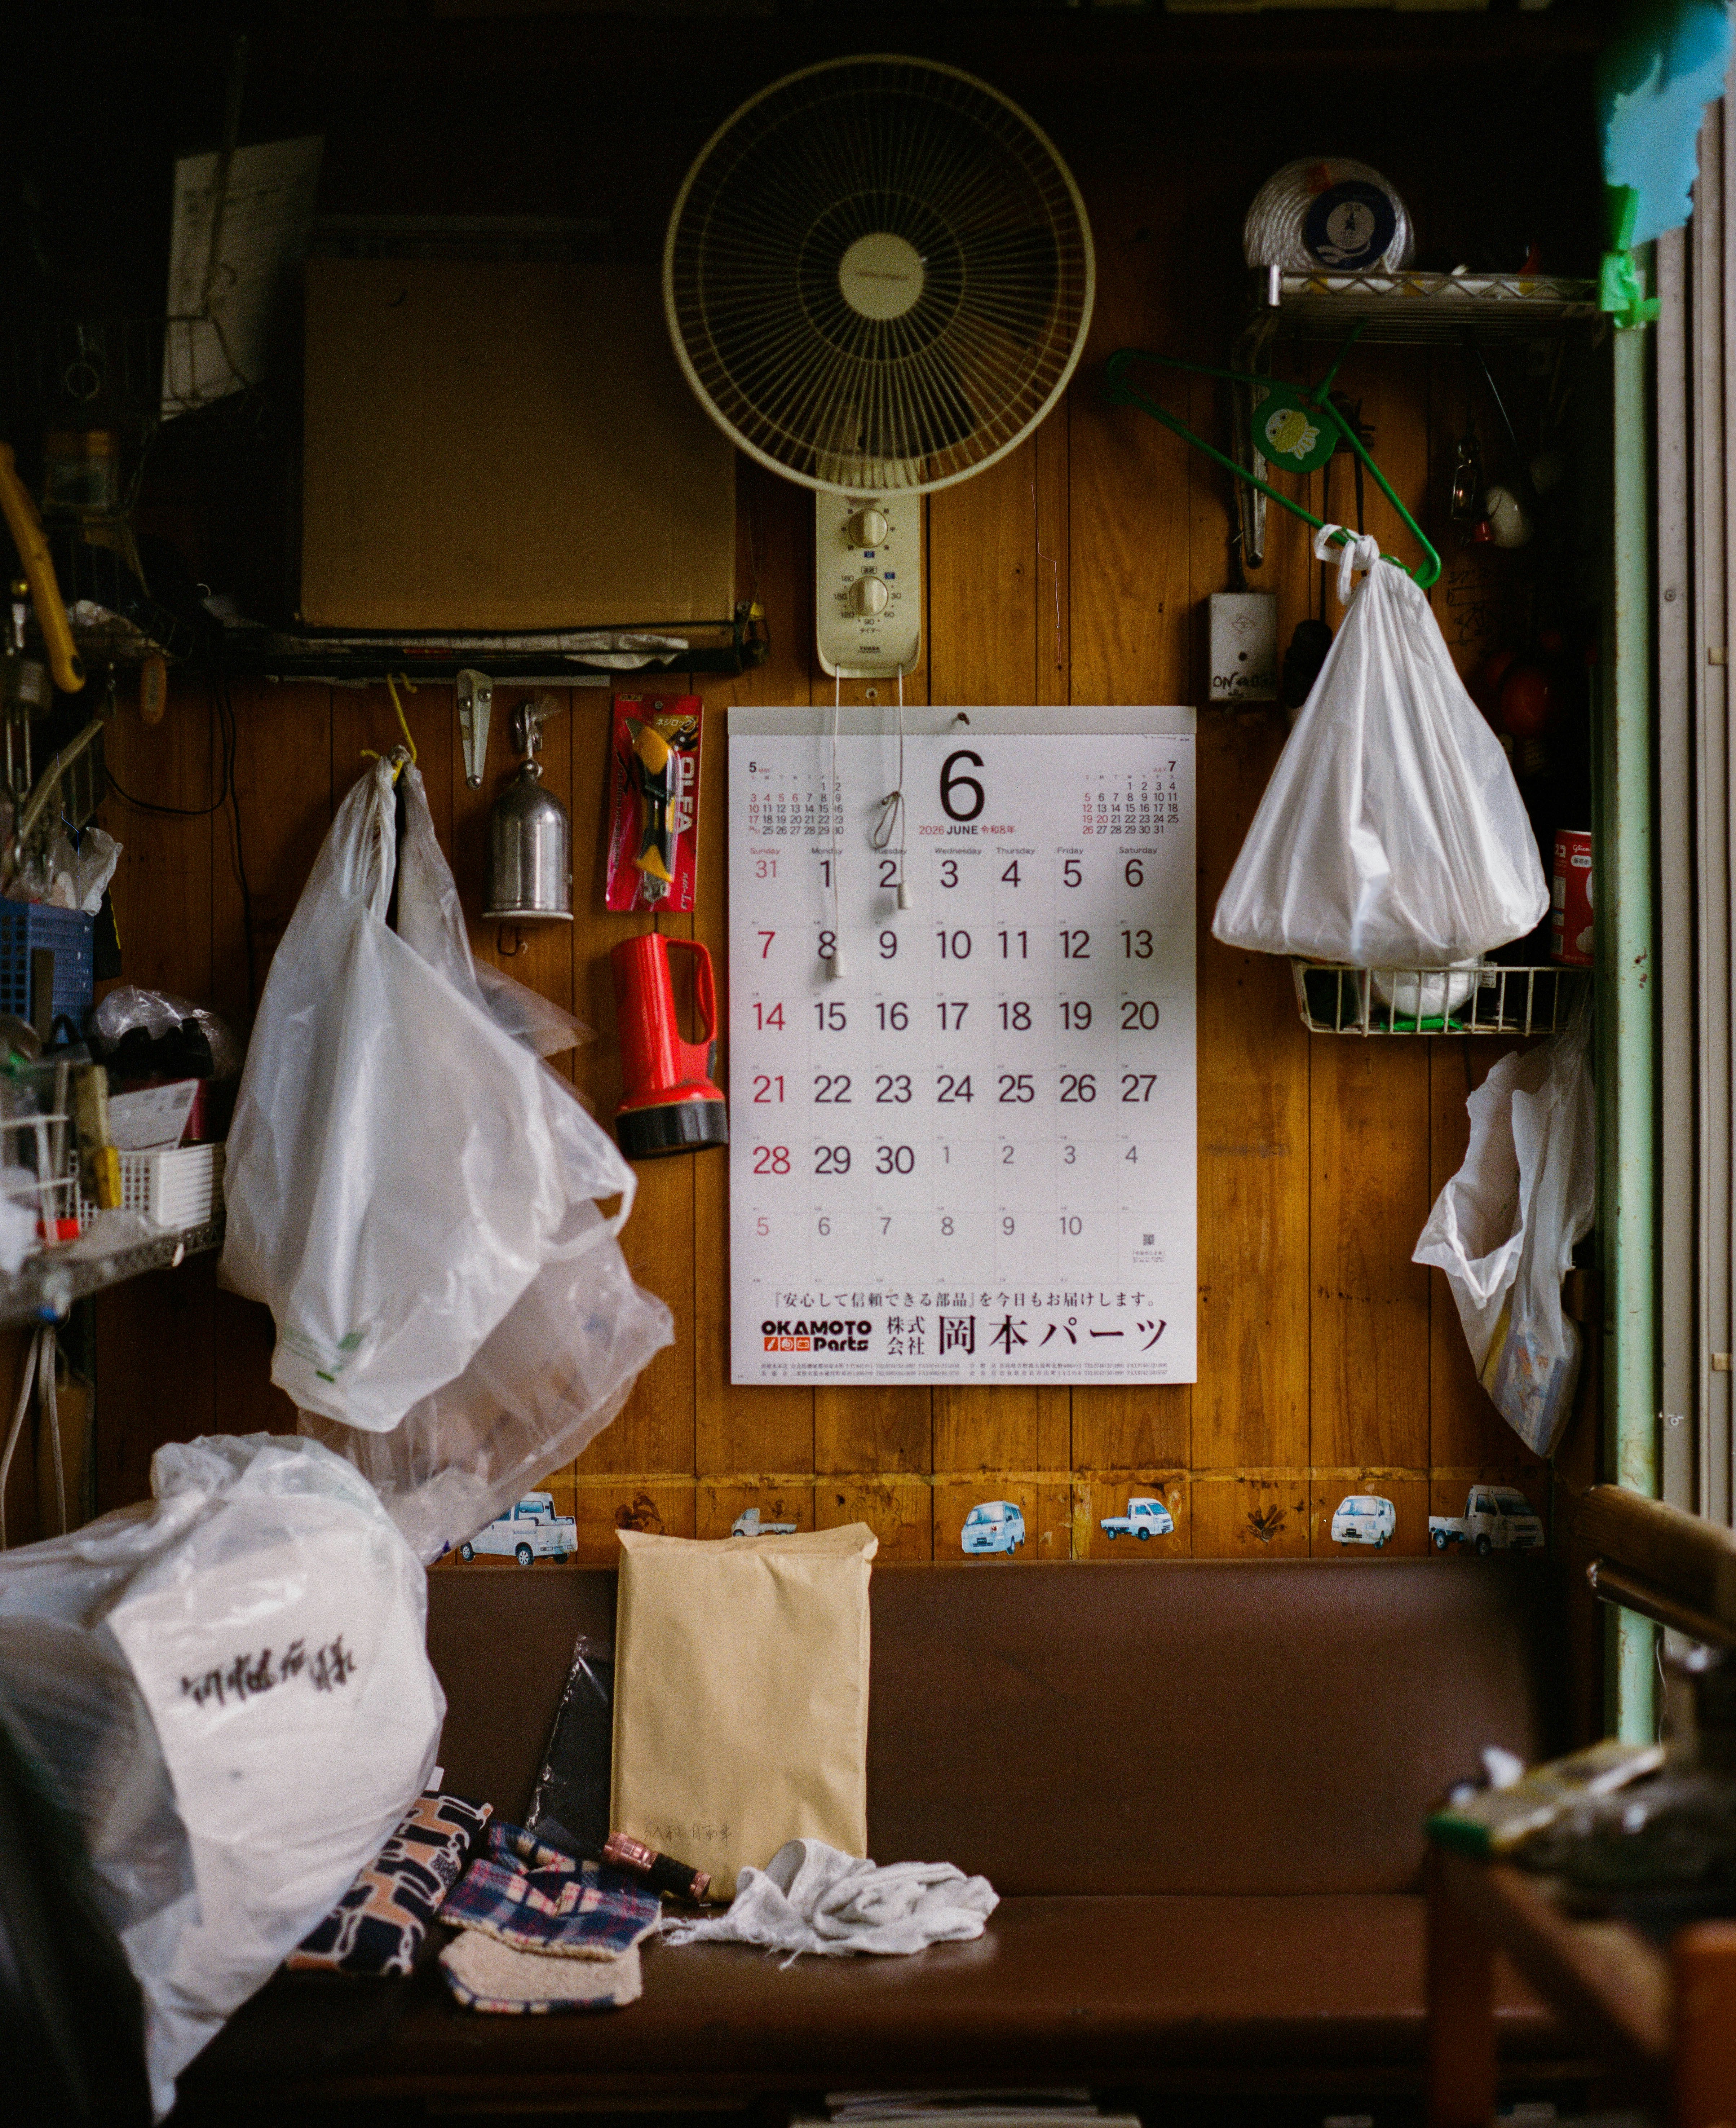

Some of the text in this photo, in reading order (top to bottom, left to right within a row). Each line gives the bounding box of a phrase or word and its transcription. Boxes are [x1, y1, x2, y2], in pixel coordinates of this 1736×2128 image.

[1212, 672, 1240, 689] ON
[750, 762, 756, 773] 5
[1169, 761, 1176, 772] 7
[940, 750, 985, 822] 6
[1142, 782, 1147, 791] 2
[1156, 782, 1162, 790] 3
[679, 757, 695, 834] OLFA
[751, 793, 757, 803] 3
[778, 794, 784, 802] 5
[792, 793, 798, 802] 6
[808, 793, 812, 802] 7
[821, 794, 827, 802] 8
[835, 794, 841, 802] 9
[1085, 793, 1177, 802] 5 6 7 8 9 10 11
[749, 804, 759, 813] 10
[777, 804, 786, 813] 12
[791, 804, 800, 813] 13
[819, 804, 829, 813] 15
[1083, 804, 1092, 813] 12
[1097, 804, 1107, 813] 13
[1126, 804, 1135, 812] 15
[1140, 804, 1149, 812] 16
[1154, 803, 1164, 812] 17
[1169, 803, 1178, 812] 18
[764, 815, 773, 824] 18
[777, 815, 786, 824] 19
[791, 815, 802, 824] 20
[805, 815, 814, 824] 21
[818, 815, 829, 824] 22
[1083, 814, 1179, 823] 19 20 21 22 23 24 25
[763, 826, 773, 834] 25
[790, 826, 801, 835] 27
[818, 826, 830, 835] 29
[919, 825, 1015, 835] 2026 JUNE 令和8年
[1097, 825, 1107, 834] 27
[1111, 825, 1122, 834] 28
[1125, 825, 1136, 834] 29
[1139, 826, 1150, 834] 30
[1154, 825, 1164, 834] 31
[750, 847, 1157, 856] Sunday Monday Tuesday Wednesday Thursday Friday Saturday
[1573, 844, 1591, 853] Glico
[756, 859, 1143, 888] 31 1 2 3 4 5 6
[758, 930, 1153, 959] 7 8 9 10 11 12 13
[753, 1001, 1159, 1031] 14 15 16 17 18 19 20
[753, 1074, 1157, 1103] 21 22 23 24 25 26 27
[753, 1145, 1138, 1174] 28 29 30 1 2 3 4
[757, 1216, 1082, 1236] 5 6 7 8 9 10
[776, 1292, 1154, 1308] 『安心して信頼できる部品』を今日もお届けします。
[762, 1321, 871, 1335] OKAMOTO
[888, 1316, 924, 1334] 株式
[940, 1315, 1167, 1355] 岡本パーツ
[814, 1336, 869, 1351] Parts
[888, 1338, 924, 1355] 会社
